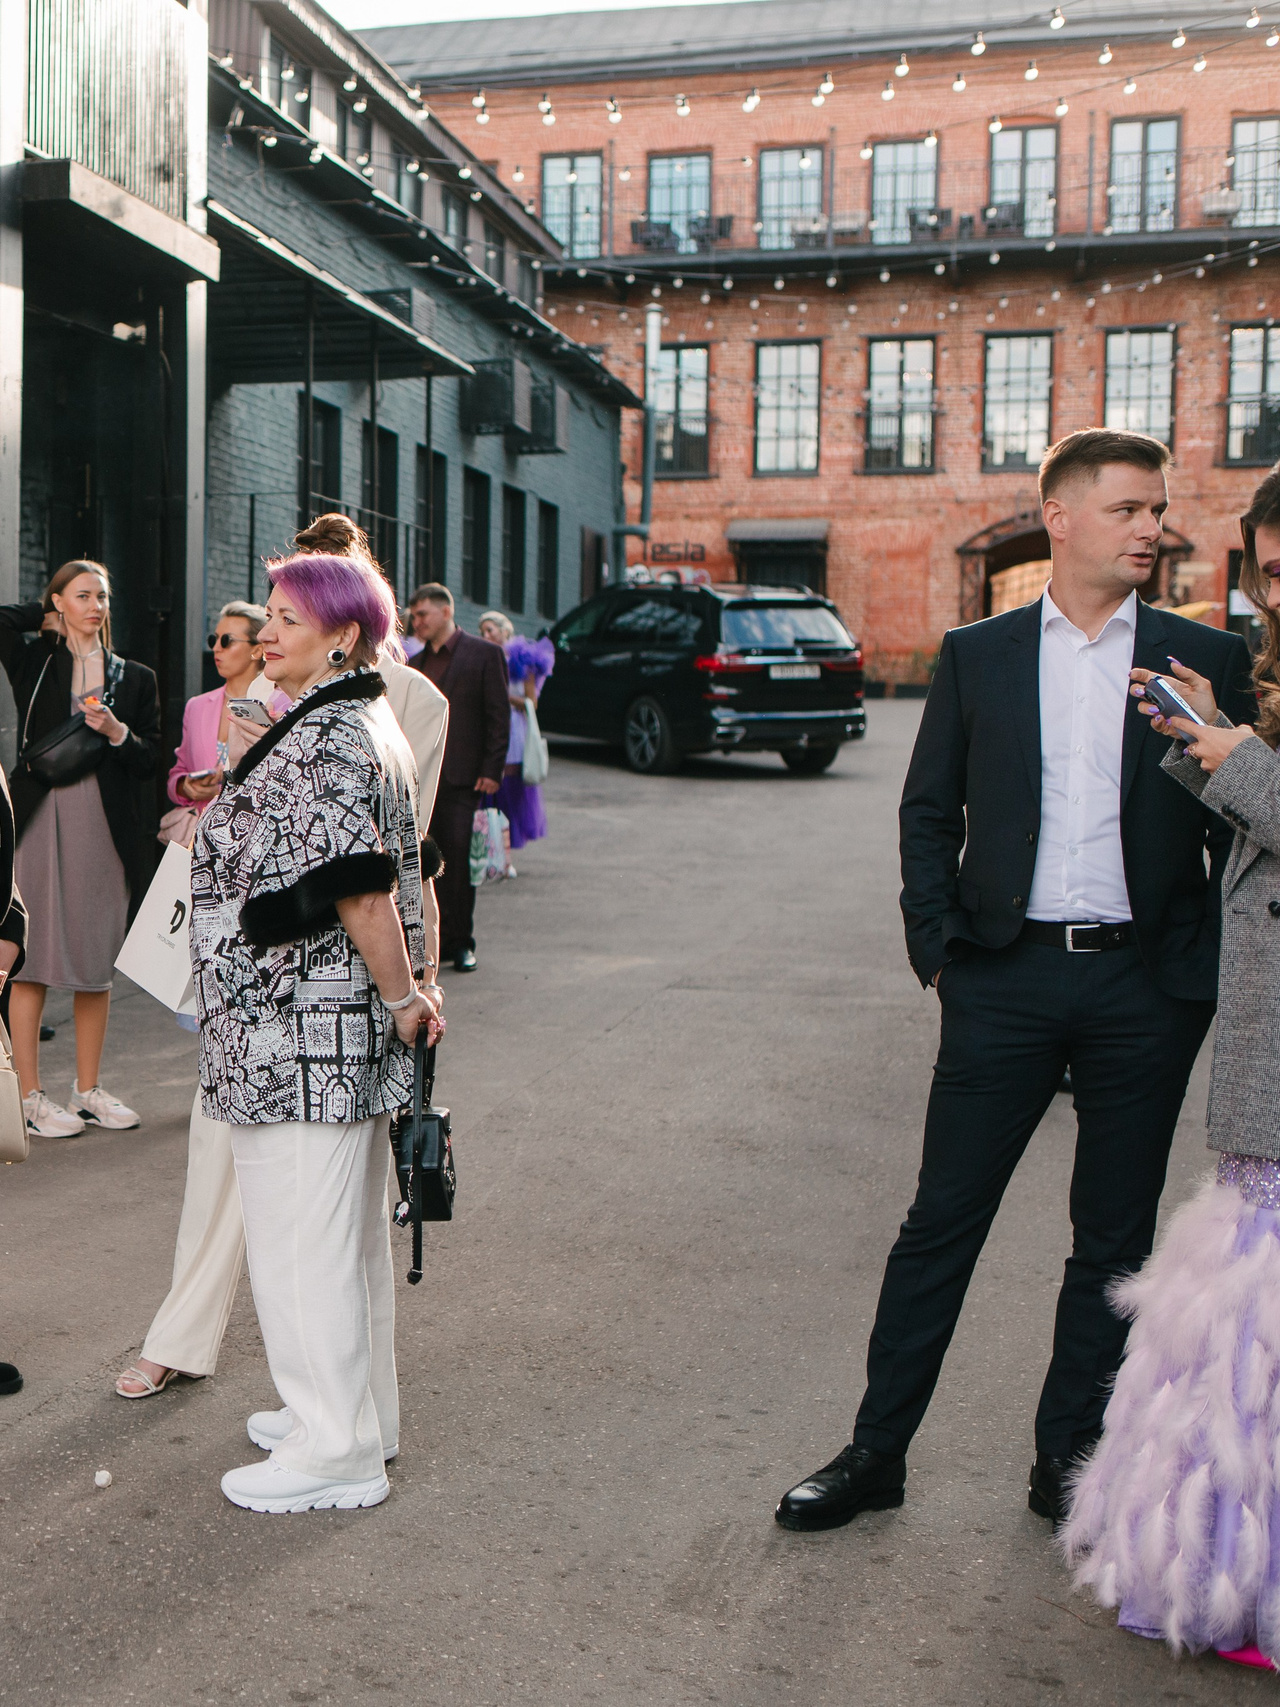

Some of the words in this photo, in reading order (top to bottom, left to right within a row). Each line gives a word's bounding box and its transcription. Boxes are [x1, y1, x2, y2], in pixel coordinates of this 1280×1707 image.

[639, 537, 706, 561] Tesla
[308, 927, 342, 952] ORANGERIE
[268, 958, 285, 974] DIVAS
[293, 1004, 312, 1012] LOTS
[319, 1004, 341, 1012] DIVAS
